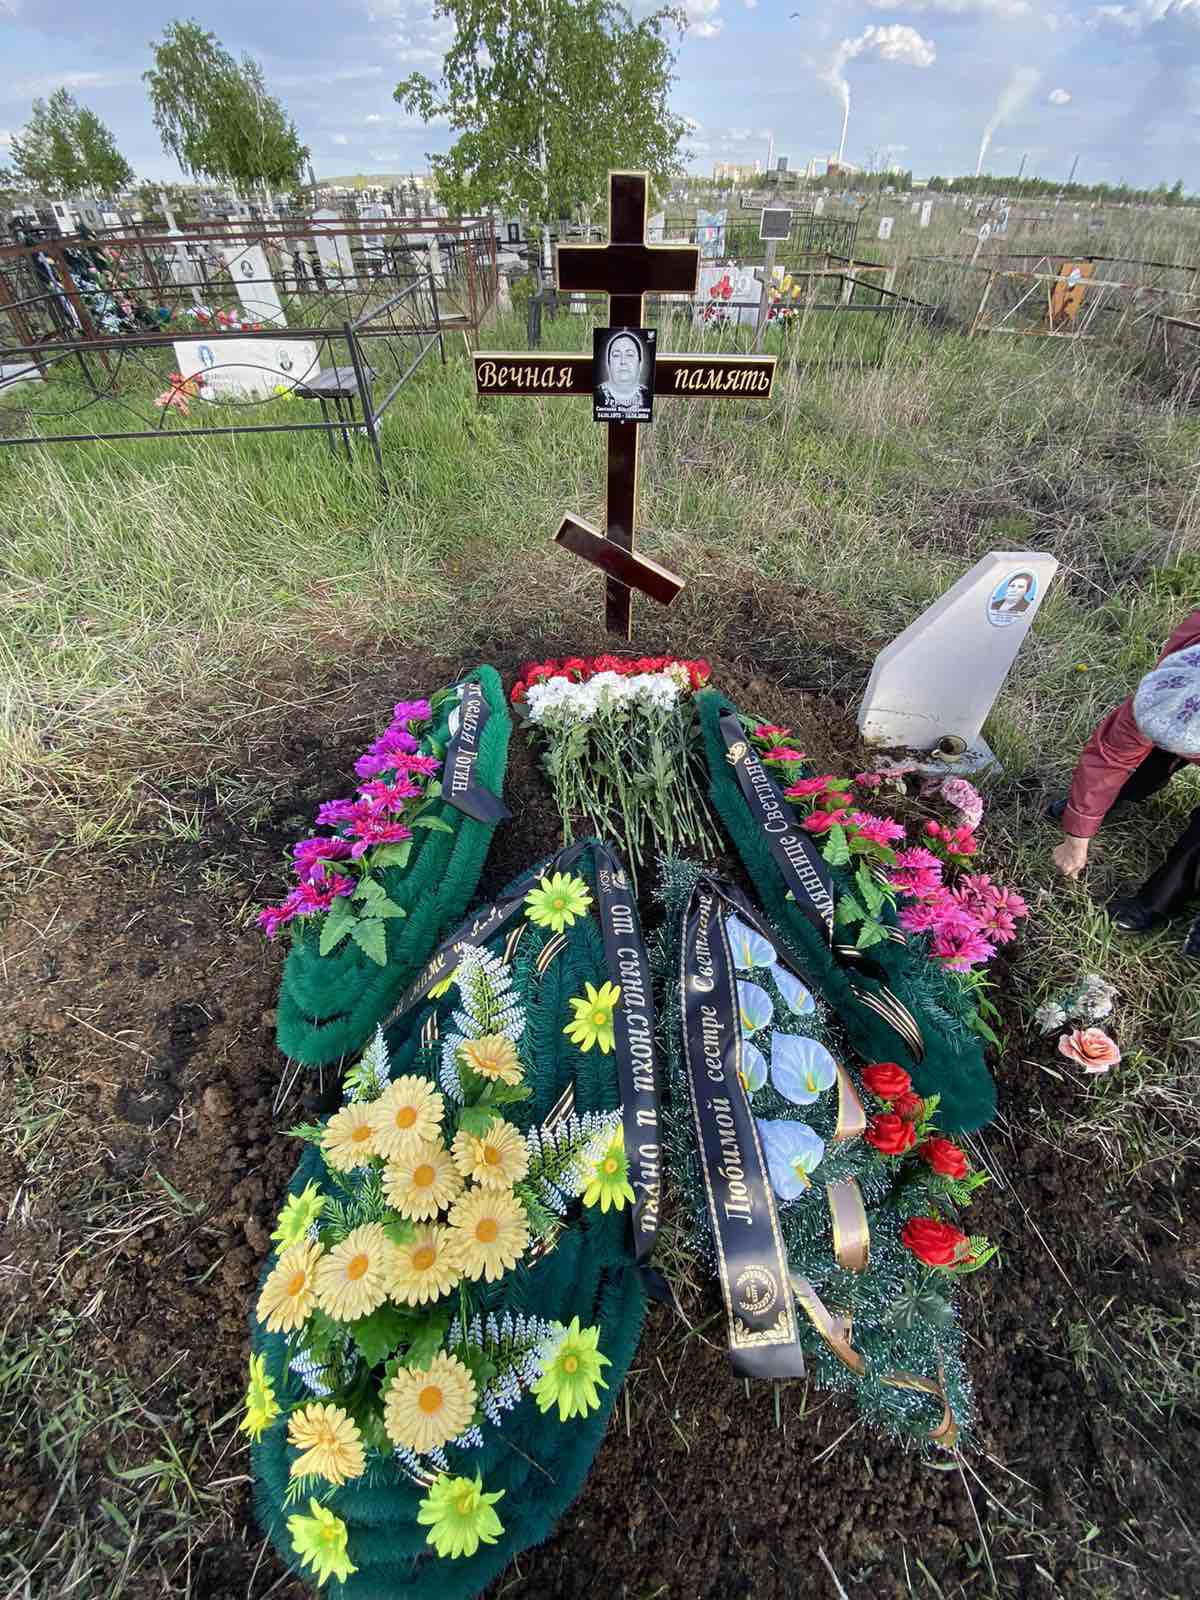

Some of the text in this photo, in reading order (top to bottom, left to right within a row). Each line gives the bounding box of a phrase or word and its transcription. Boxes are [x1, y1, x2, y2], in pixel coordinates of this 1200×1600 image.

[478, 361, 770, 391] Вечная память
[611, 905, 634, 936] от
[636, 1108, 657, 1127] и
[693, 895, 752, 1225] Любимой сестре Светлане
